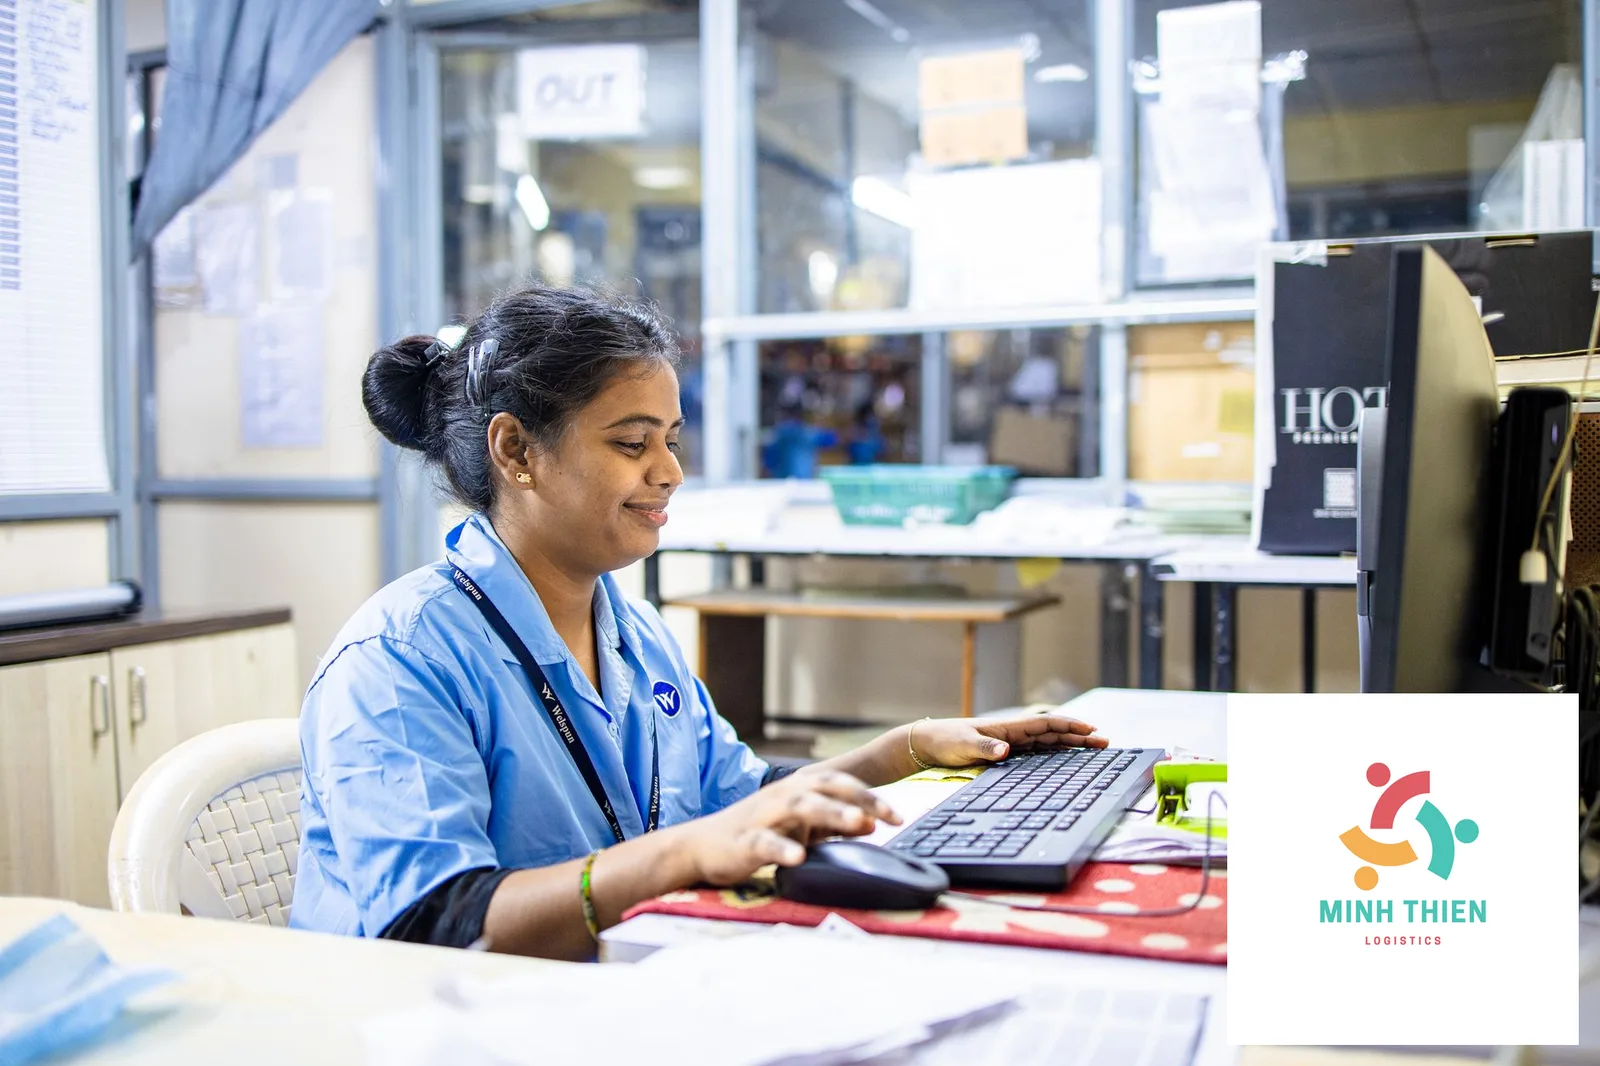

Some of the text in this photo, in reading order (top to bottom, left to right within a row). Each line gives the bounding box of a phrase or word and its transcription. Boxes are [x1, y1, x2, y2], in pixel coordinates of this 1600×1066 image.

[534, 72, 619, 109] OUT
[453, 569, 482, 601] Welspun
[552, 704, 575, 744] Welspun
[650, 776, 659, 813] Welspun
